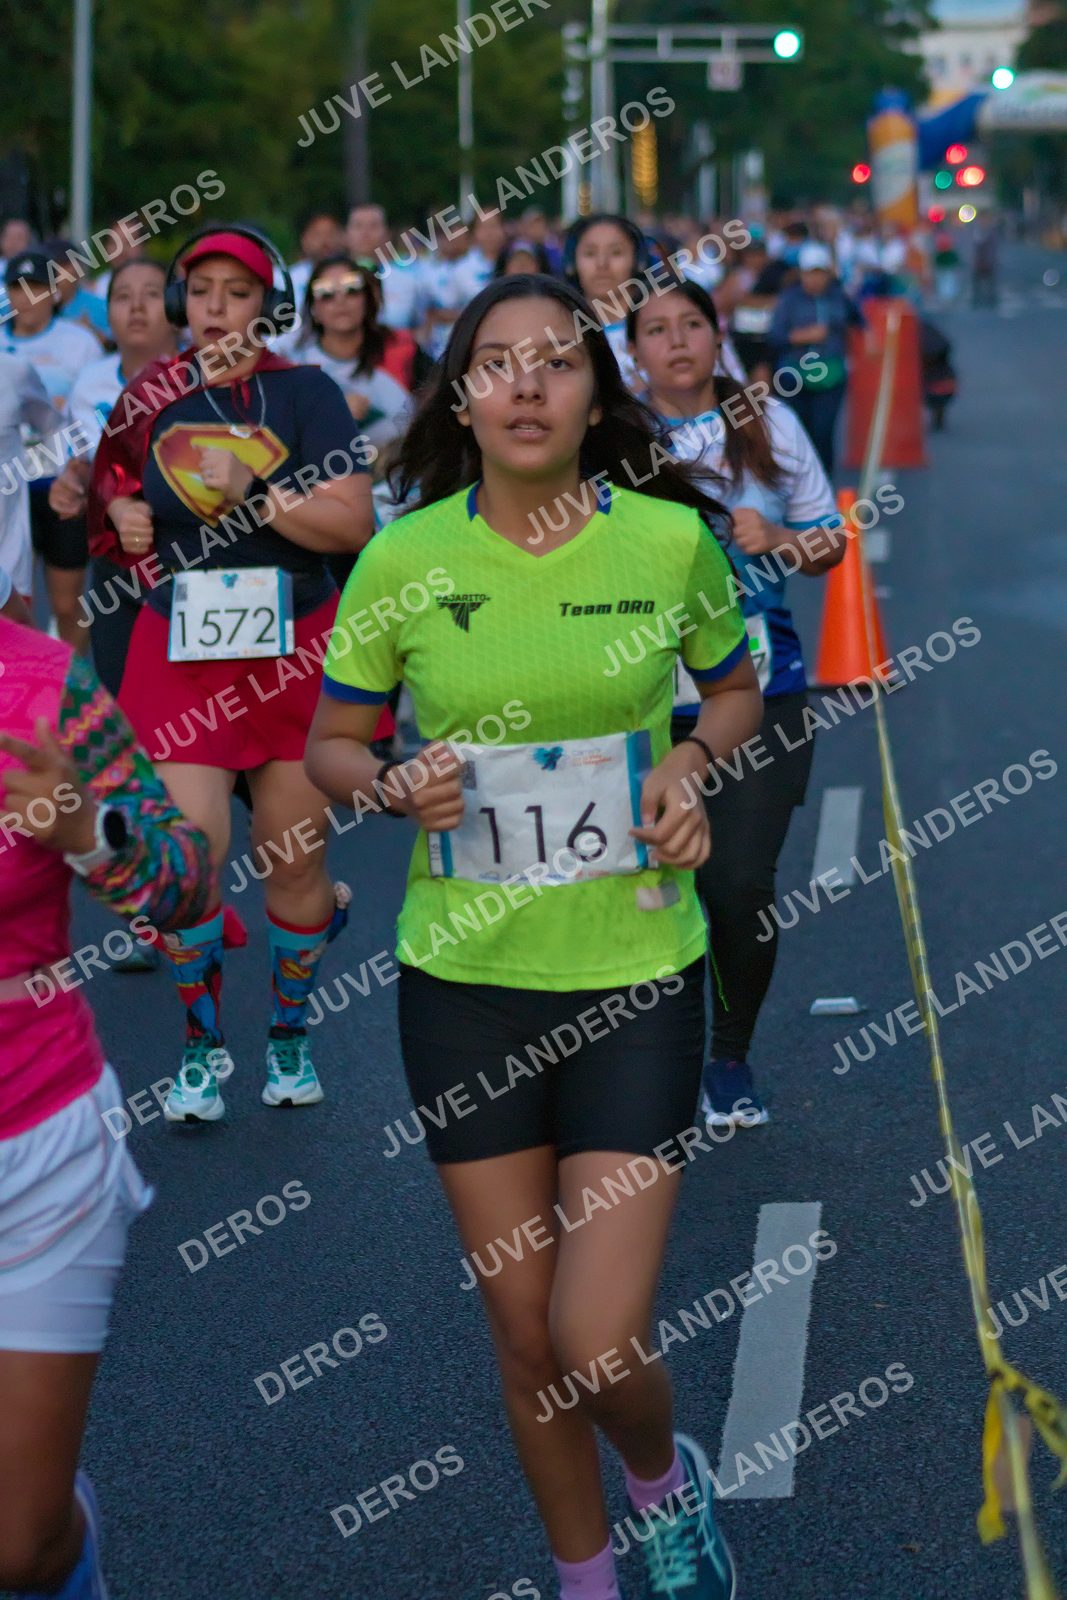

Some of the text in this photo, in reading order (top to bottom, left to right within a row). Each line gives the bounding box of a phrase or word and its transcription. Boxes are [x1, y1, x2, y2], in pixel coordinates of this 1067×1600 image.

[177, 607, 276, 648] 1572
[559, 602, 612, 617] Team
[478, 801, 607, 864] 116
